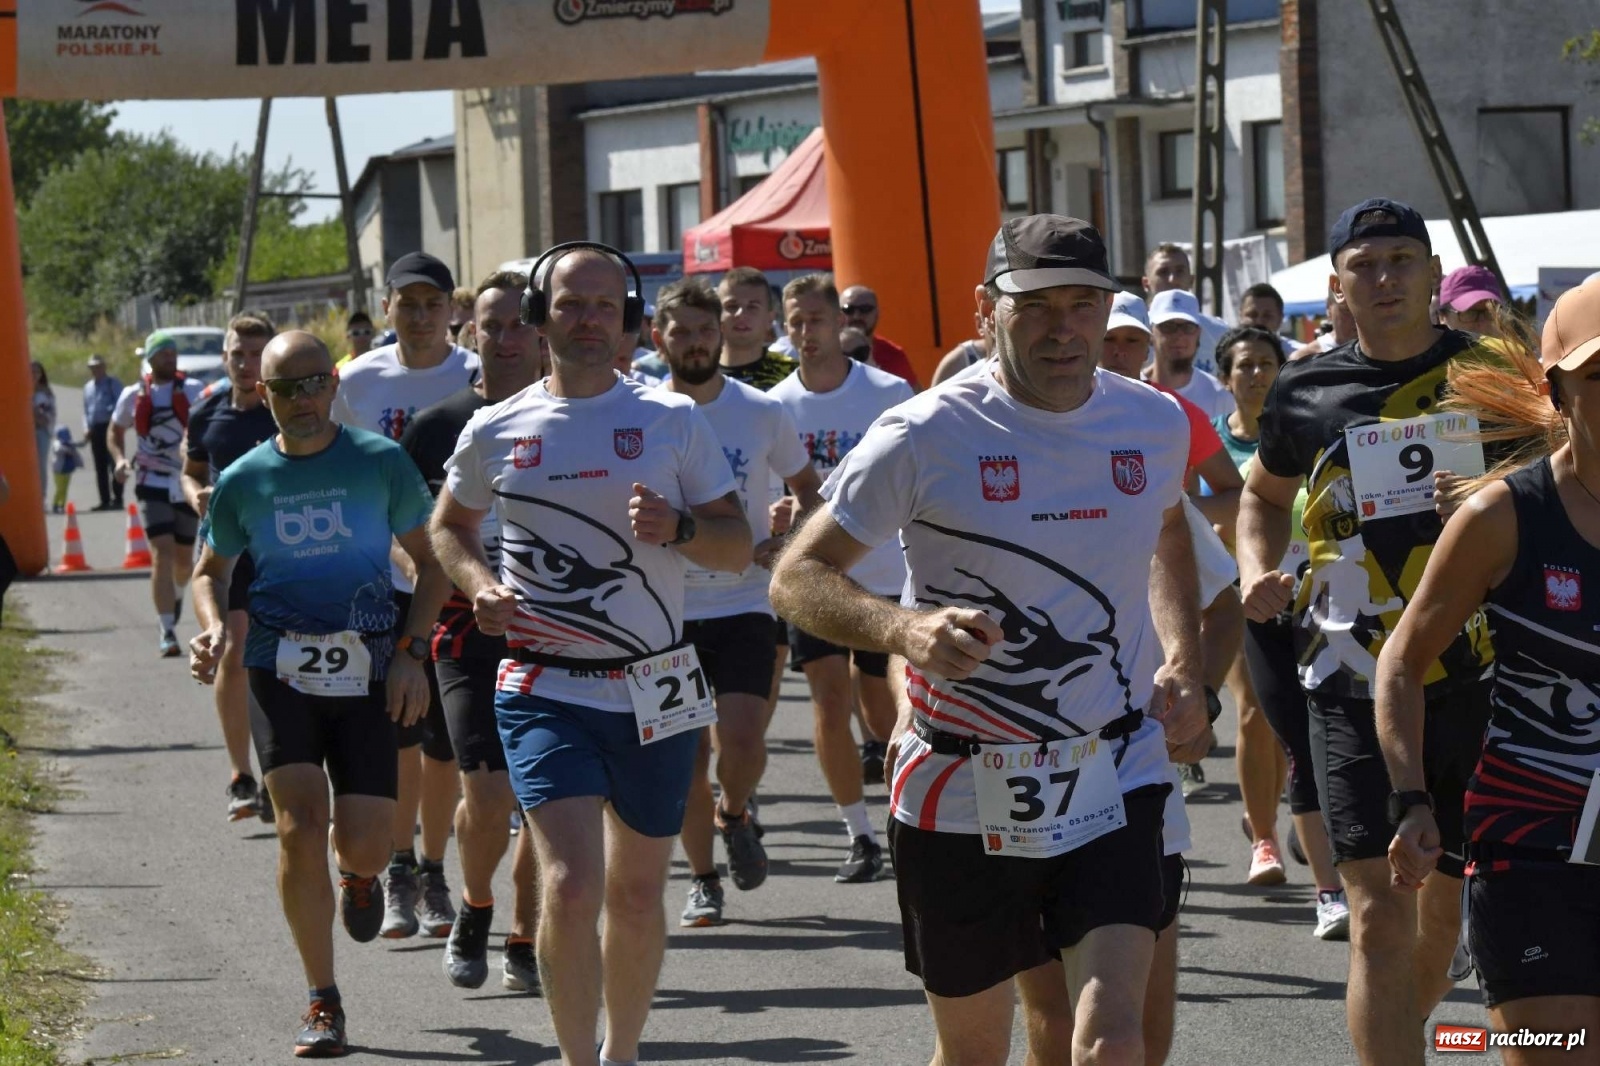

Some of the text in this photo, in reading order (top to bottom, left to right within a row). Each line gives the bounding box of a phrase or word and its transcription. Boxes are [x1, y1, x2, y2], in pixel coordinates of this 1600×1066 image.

[57, 24, 161, 39] MARATONY
[56, 43, 162, 57] POLSKIE.PL
[1357, 416, 1468, 447] COLOUR RUN
[1399, 443, 1434, 483] 9
[1543, 563, 1581, 575] POLSKA
[298, 646, 349, 675] 29
[633, 652, 691, 679] COLOUR
[655, 667, 706, 712] 21
[982, 738, 1098, 770] COLOUR RUN
[1006, 767, 1080, 822] 37
[984, 803, 1120, 834] 10km, Krzanowice, 05.09.2021
